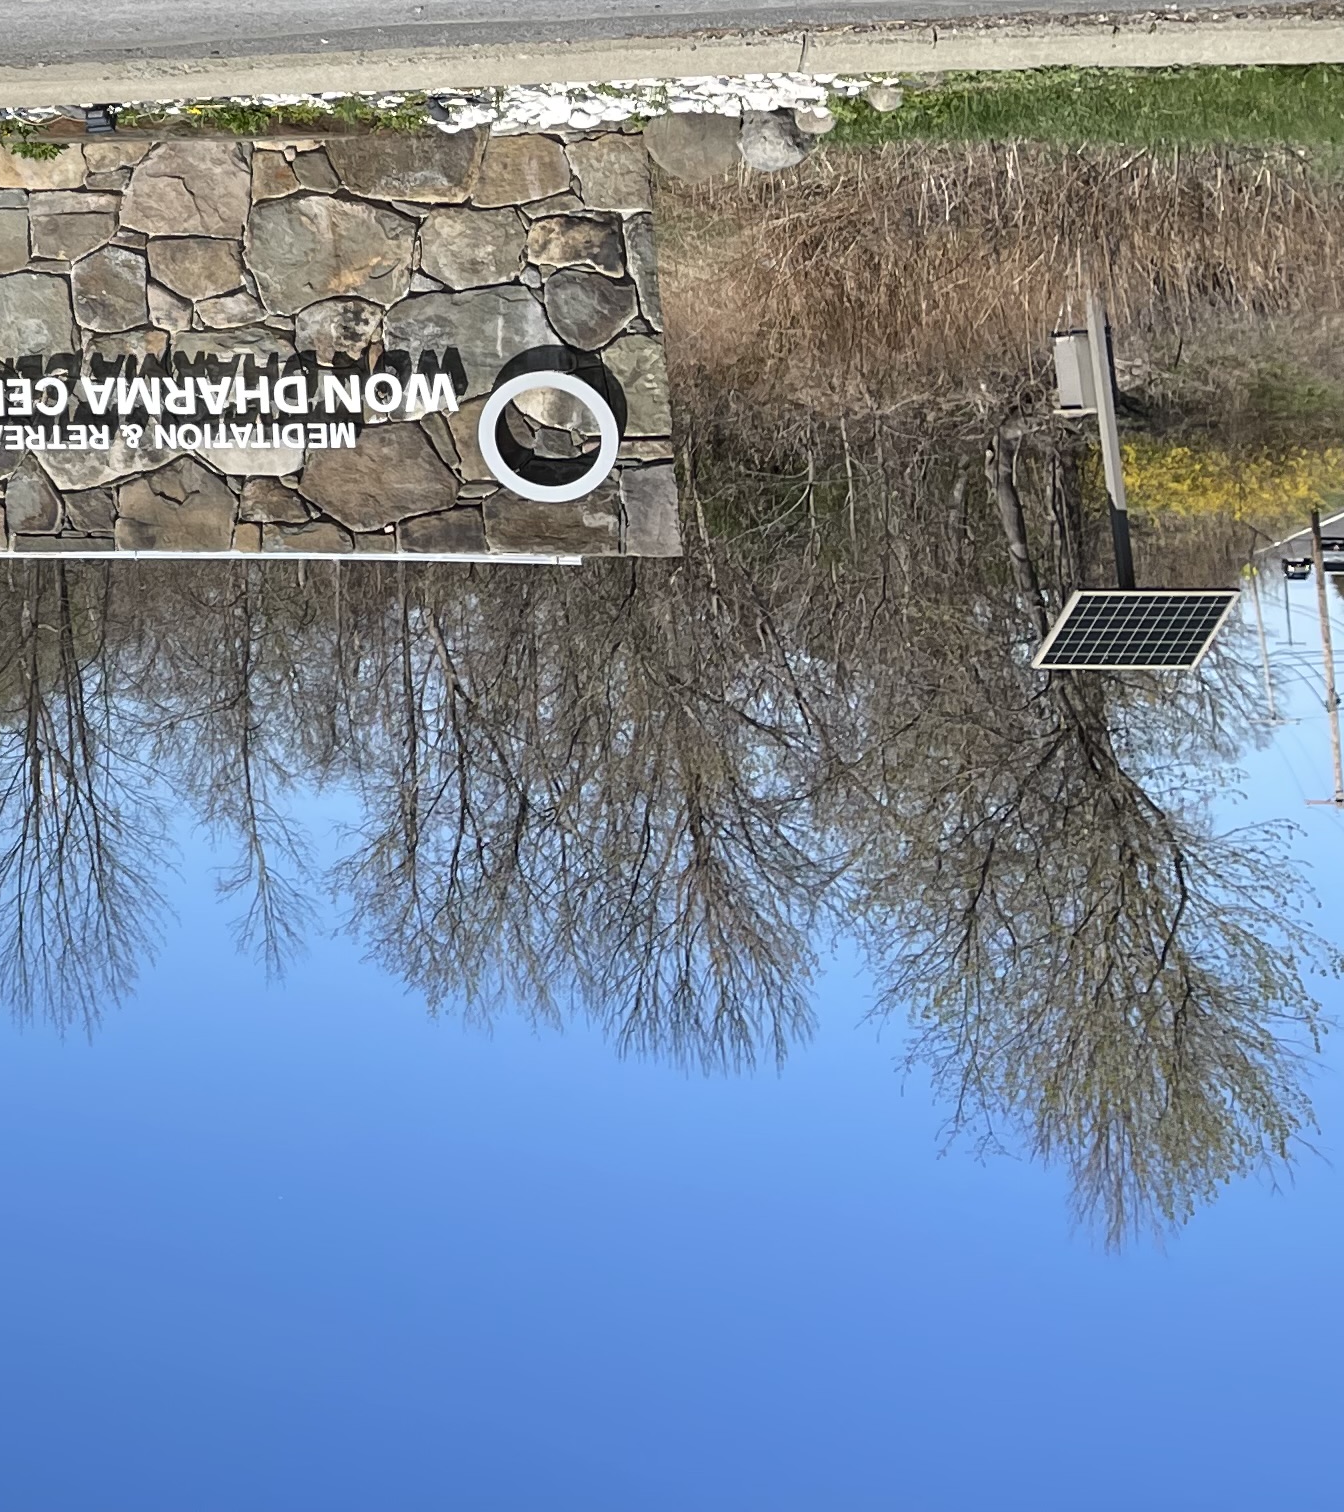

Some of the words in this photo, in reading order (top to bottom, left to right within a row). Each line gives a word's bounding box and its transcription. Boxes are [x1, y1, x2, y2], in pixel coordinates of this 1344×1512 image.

[80, 374, 308, 416] DHARMA
[323, 373, 460, 414] WON
[120, 423, 144, 449] &
[154, 422, 357, 450] MEDITATION
